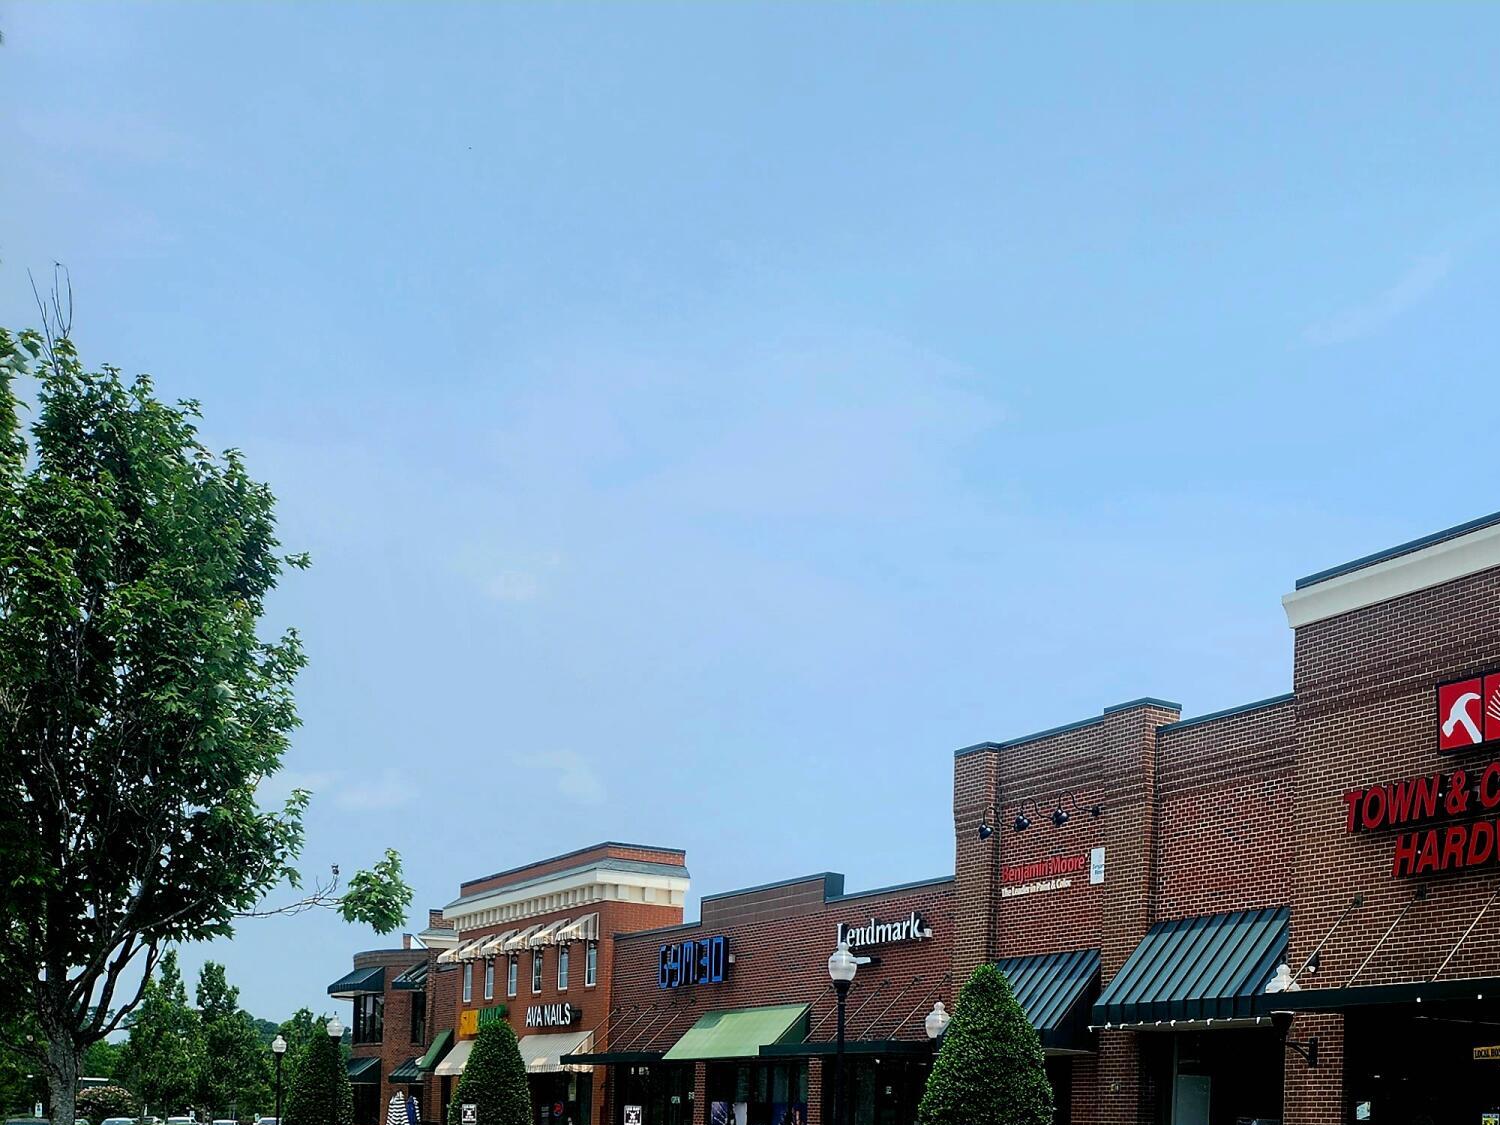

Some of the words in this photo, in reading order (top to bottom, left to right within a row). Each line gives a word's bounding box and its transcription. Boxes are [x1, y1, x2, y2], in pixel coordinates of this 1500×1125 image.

[1344, 775, 1441, 833] TOWN
[1446, 770, 1470, 814] &
[836, 911, 922, 948] Lendmark
[525, 1005, 543, 1027] AVA
[544, 1002, 571, 1025] NAILS
